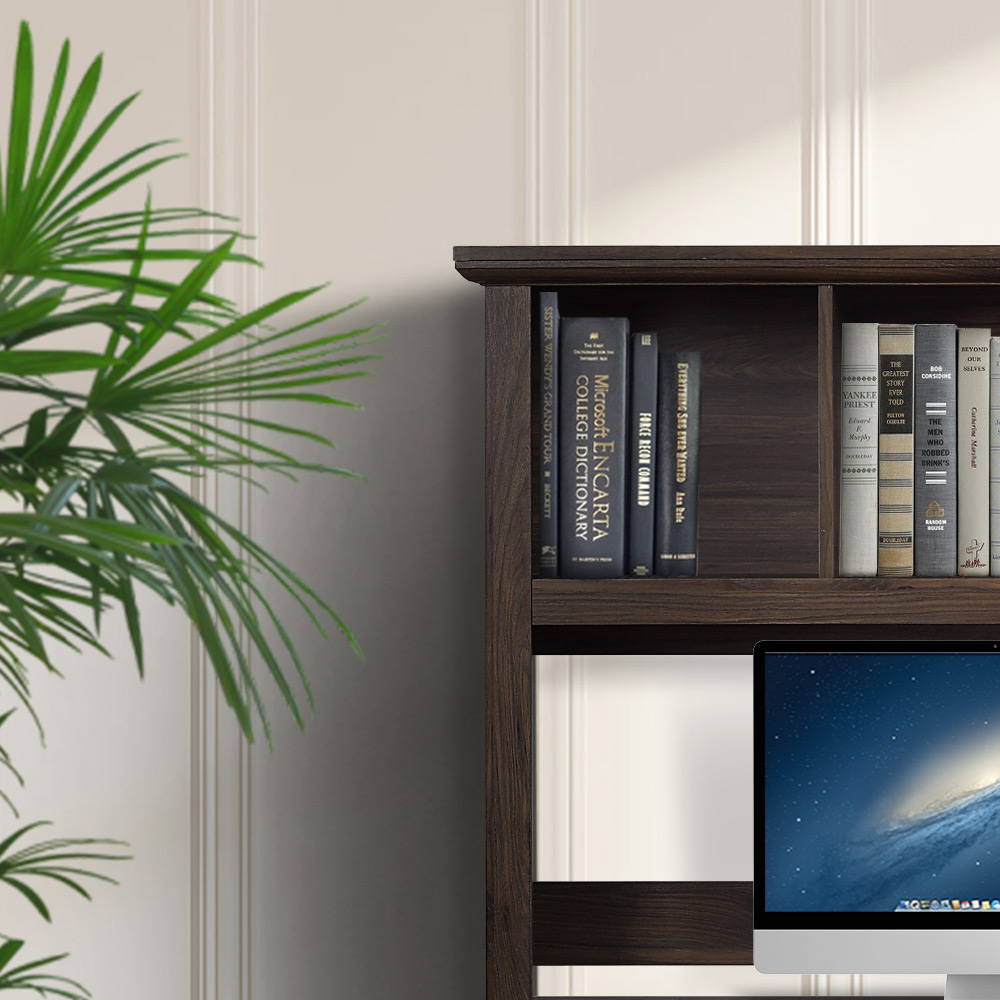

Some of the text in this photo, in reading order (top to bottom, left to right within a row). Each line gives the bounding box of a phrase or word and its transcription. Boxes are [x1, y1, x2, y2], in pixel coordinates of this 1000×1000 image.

[544, 306, 553, 341] SISTER
[843, 391, 877, 399] YANKEE
[543, 392, 552, 432] GRAND
[543, 433, 552, 464] TOUR
[849, 434, 871, 442] Murphy
[921, 449, 950, 457] ROBBED
[575, 375, 589, 541] COLLEGE DICTIONARY
[592, 375, 614, 541] Microsoft ENCARTA
[637, 413, 652, 507] FORCE RECON COMMAND
[921, 459, 950, 467] BRINK'S
